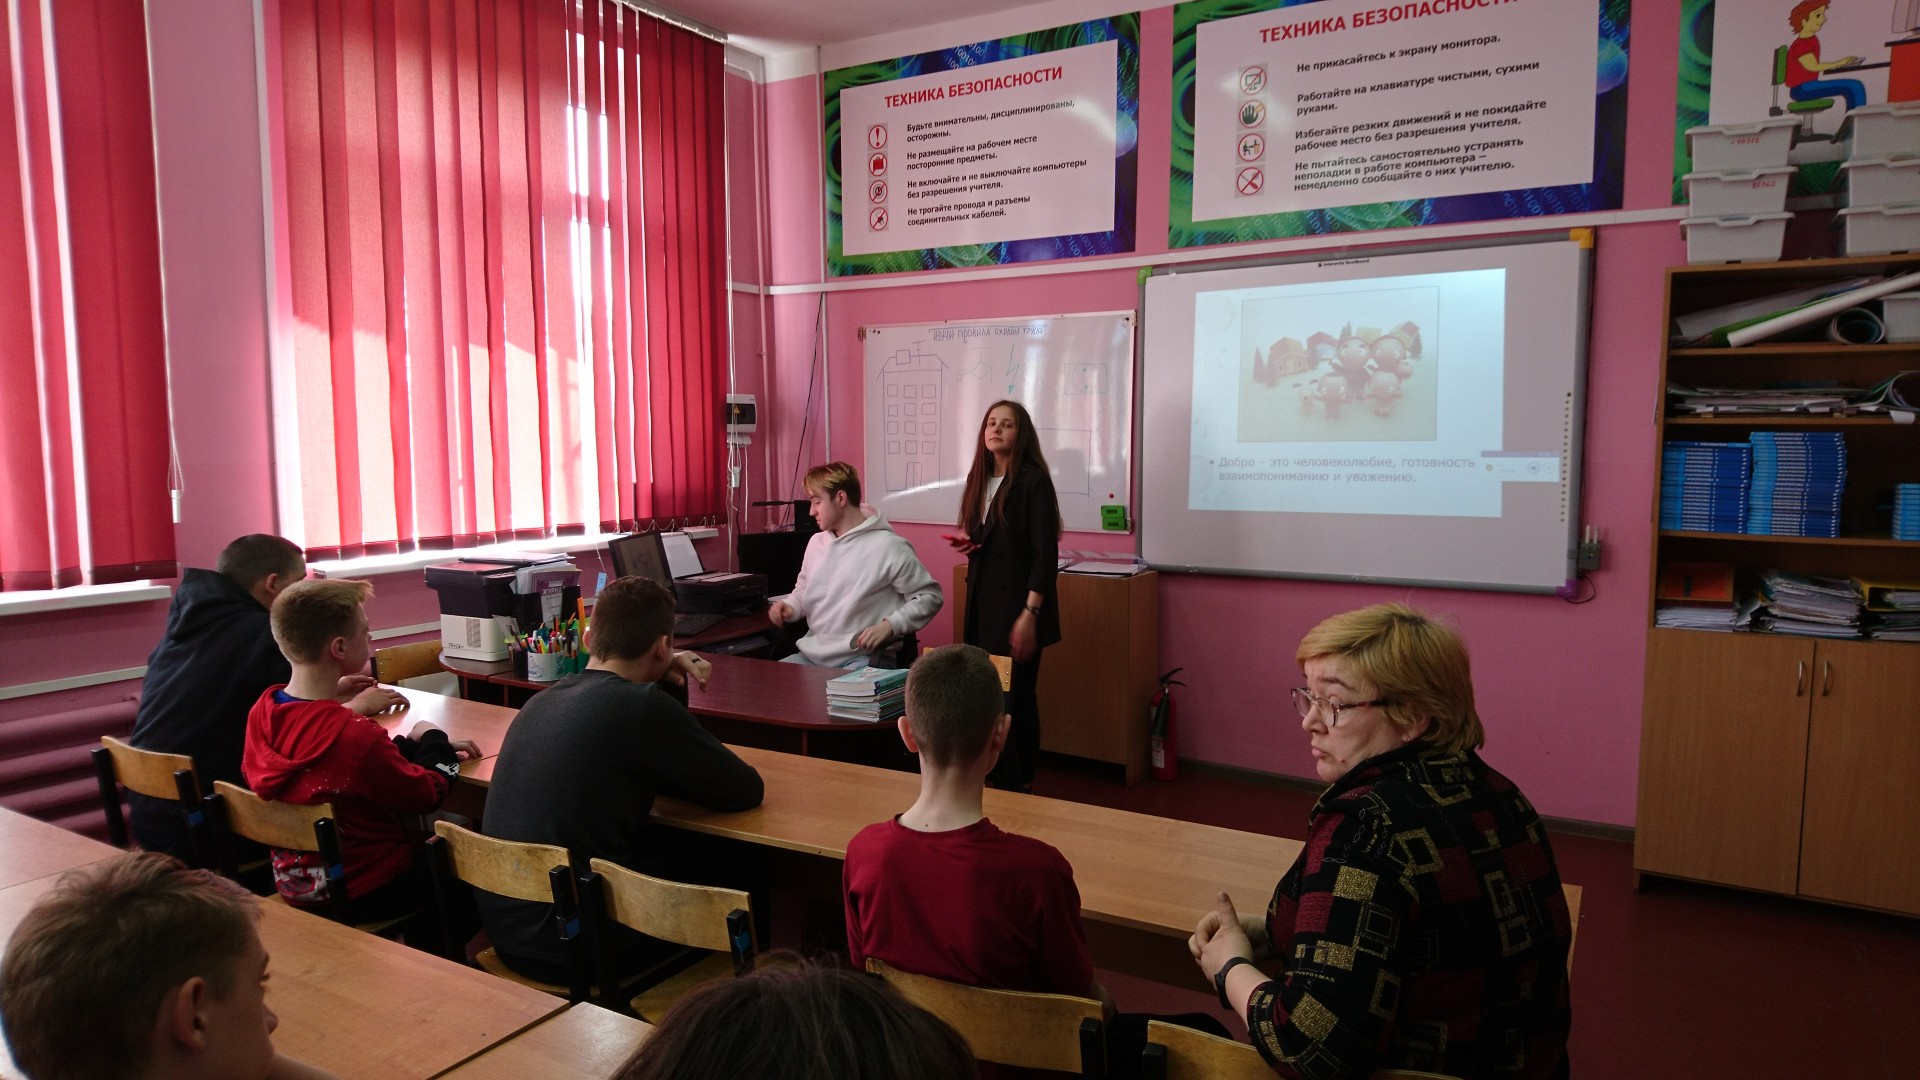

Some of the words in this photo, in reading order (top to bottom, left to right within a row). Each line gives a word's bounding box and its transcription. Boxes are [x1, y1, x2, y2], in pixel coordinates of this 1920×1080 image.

[1259, 16, 1346, 43] ТЕХНИКА
[1352, 0, 1518, 28] БЕЗОПАСНО
[1297, 63, 1311, 73] Не
[1313, 53, 1387, 71] прикасайтесь
[1389, 50, 1396, 59] к
[1398, 44, 1438, 57] экрану
[1441, 35, 1501, 51] монитора.
[884, 87, 945, 108] ТЕХНИКА
[948, 66, 1062, 98] БЕЗОПАСНОСТИ
[1297, 88, 1352, 103] Работайте
[1354, 86, 1367, 95] на
[1370, 76, 1435, 92] клавиатуре
[1437, 69, 1492, 82] чистыми,
[1495, 61, 1539, 76] сухими
[907, 122, 933, 133] Будьте
[934, 113, 989, 128] внимательны,
[990, 99, 1076, 121] дисциплинированы,
[1295, 125, 1349, 140] Избегайте
[1352, 121, 1390, 134] резких
[1392, 110, 1451, 128] движений
[1465, 109, 1479, 118] не
[1482, 100, 1547, 116] покидайте
[1296, 103, 1338, 117] руками.
[906, 130, 951, 143] осторожны.
[906, 152, 917, 160] Не
[918, 145, 965, 160] размещайте
[966, 144, 976, 152] на
[977, 139, 1012, 152] рабочем
[1013, 135, 1038, 145] месте
[1294, 140, 1338, 154] рабочее
[1340, 135, 1372, 146] место
[1374, 132, 1393, 142] без
[1396, 124, 1466, 141] разрешения
[1469, 117, 1521, 133] учителя.
[906, 158, 955, 171] посторонние
[956, 152, 998, 165] предметы.
[1294, 168, 1352, 181] неполадки
[1354, 167, 1361, 175] в
[1363, 162, 1402, 176] работе
[1404, 154, 1476, 169] компьютера
[1295, 162, 1309, 171] Не
[1311, 156, 1367, 169] пытайтесь
[1369, 145, 1461, 163] самостоятельно
[1463, 138, 1524, 154] устранять
[907, 180, 917, 189] Не
[918, 175, 960, 187] включайте
[968, 173, 978, 181] не
[980, 165, 1031, 179] выключайте
[1032, 159, 1087, 173] компьютеры
[1294, 177, 1359, 191] немедленно
[1361, 170, 1423, 184] сообщайте
[1425, 169, 1432, 178] о
[1435, 167, 1456, 176] них
[1459, 161, 1515, 176] учителю.
[907, 190, 920, 199] без
[921, 186, 967, 199] разрешения
[969, 181, 1003, 193] учителя.
[907, 208, 918, 216] Не
[918, 204, 952, 216] трогайте
[953, 201, 986, 212] провода
[994, 196, 1031, 208] разъемы
[907, 213, 970, 226] соединительных
[971, 207, 1007, 219] кабелей.
[1218, 456, 1255, 469] Добро
[1269, 458, 1289, 467] это
[1293, 455, 1396, 469] человеколюбие,
[1401, 459, 1476, 468] готовность
[1219, 472, 1329, 481] взаимопониманию
[1333, 473, 1341, 481] и
[1345, 473, 1416, 484] уважению.
